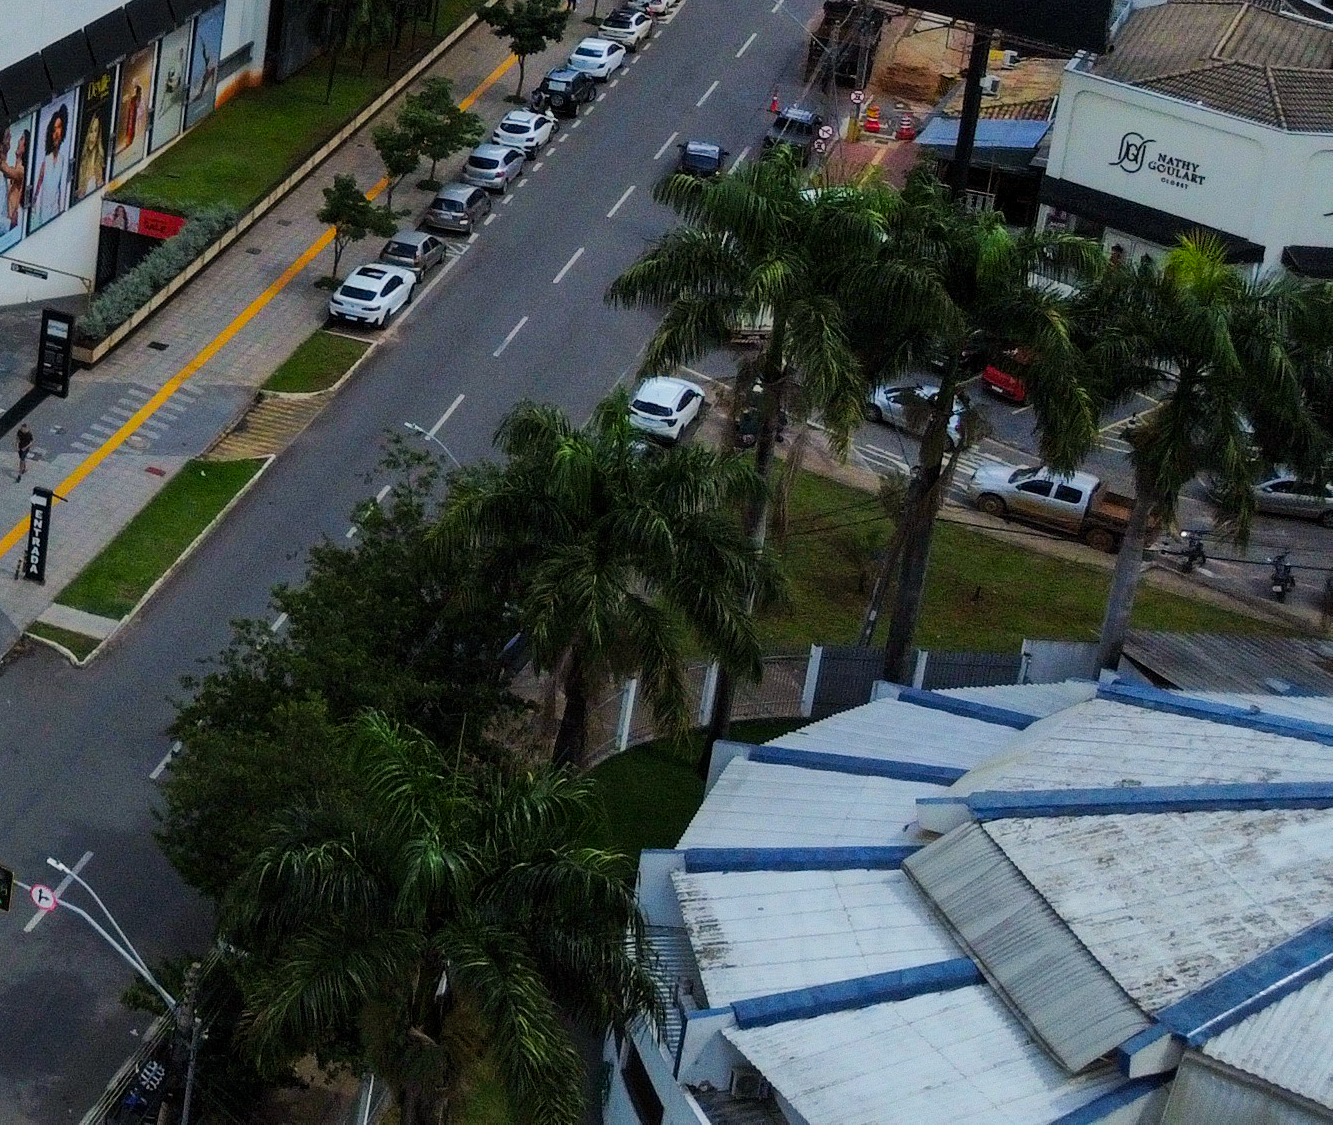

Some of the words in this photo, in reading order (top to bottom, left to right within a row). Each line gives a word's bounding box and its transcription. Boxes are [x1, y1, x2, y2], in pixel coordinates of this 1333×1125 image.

[1148, 160, 1206, 186] GOULART
[1157, 152, 1200, 174] NATHY
[1160, 177, 1189, 190] CLOSET
[29, 509, 44, 575] ENTRADA
